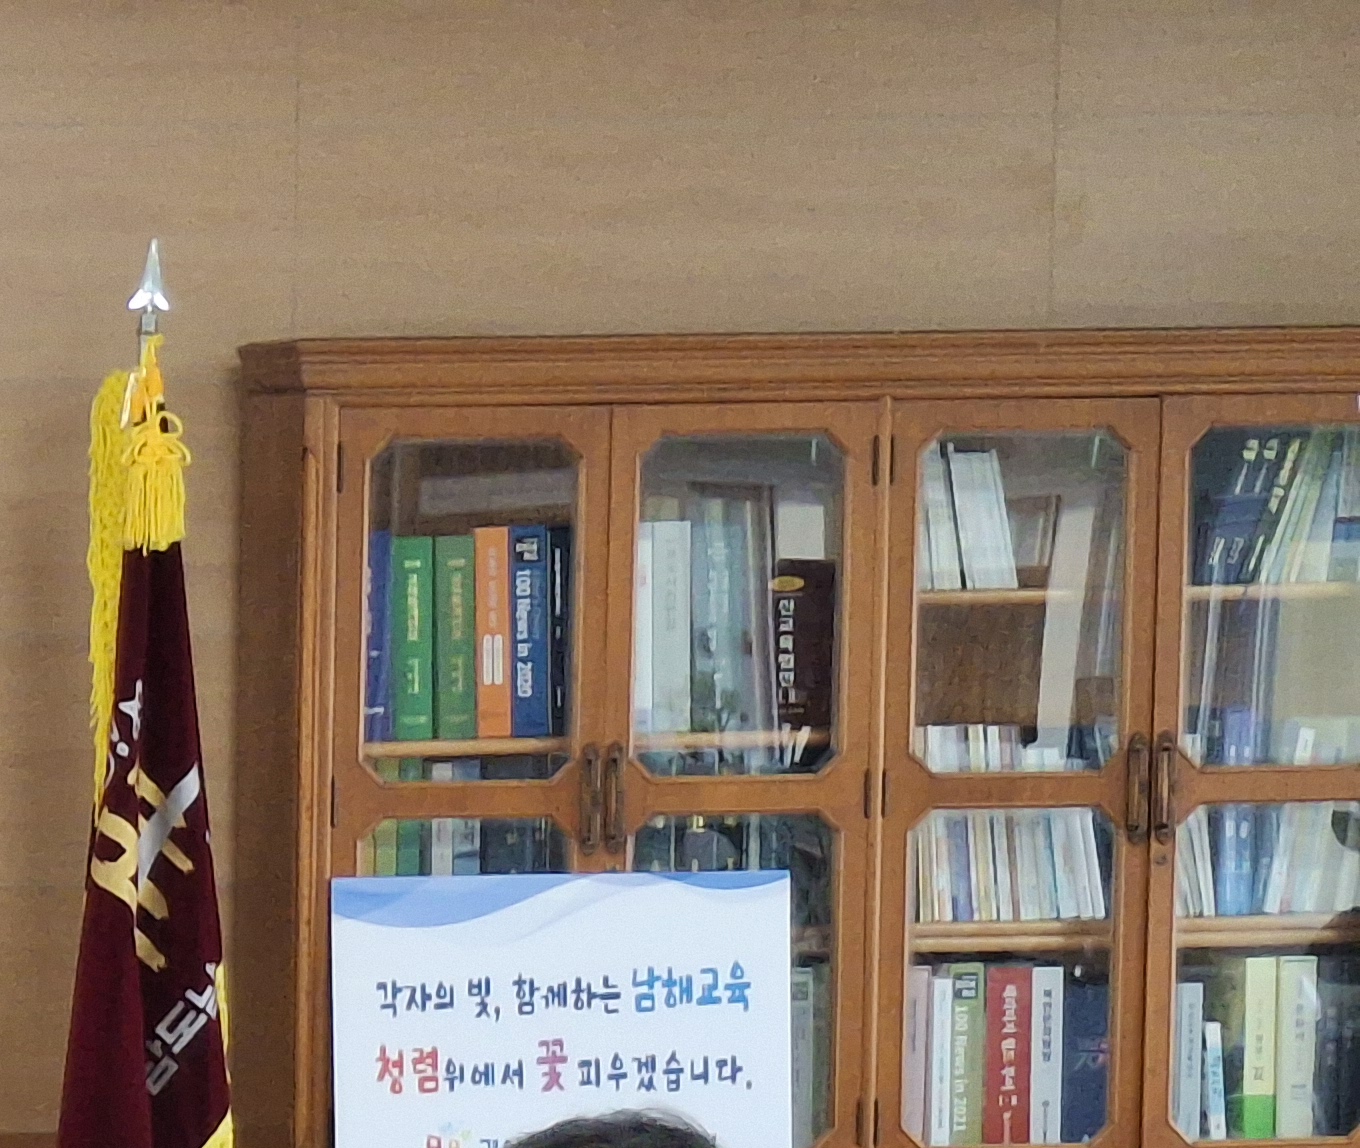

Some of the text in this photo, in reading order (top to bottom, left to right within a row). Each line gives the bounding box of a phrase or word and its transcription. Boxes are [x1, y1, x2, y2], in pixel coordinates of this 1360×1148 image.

[375, 960, 752, 1022] 각자의 빛, 함께하는 남해교육
[954, 1005, 969, 1031] 100
[536, 1038, 569, 1093] 꽃
[577, 1050, 754, 1093] 피우겠습니다.
[954, 1035, 968, 1076] News
